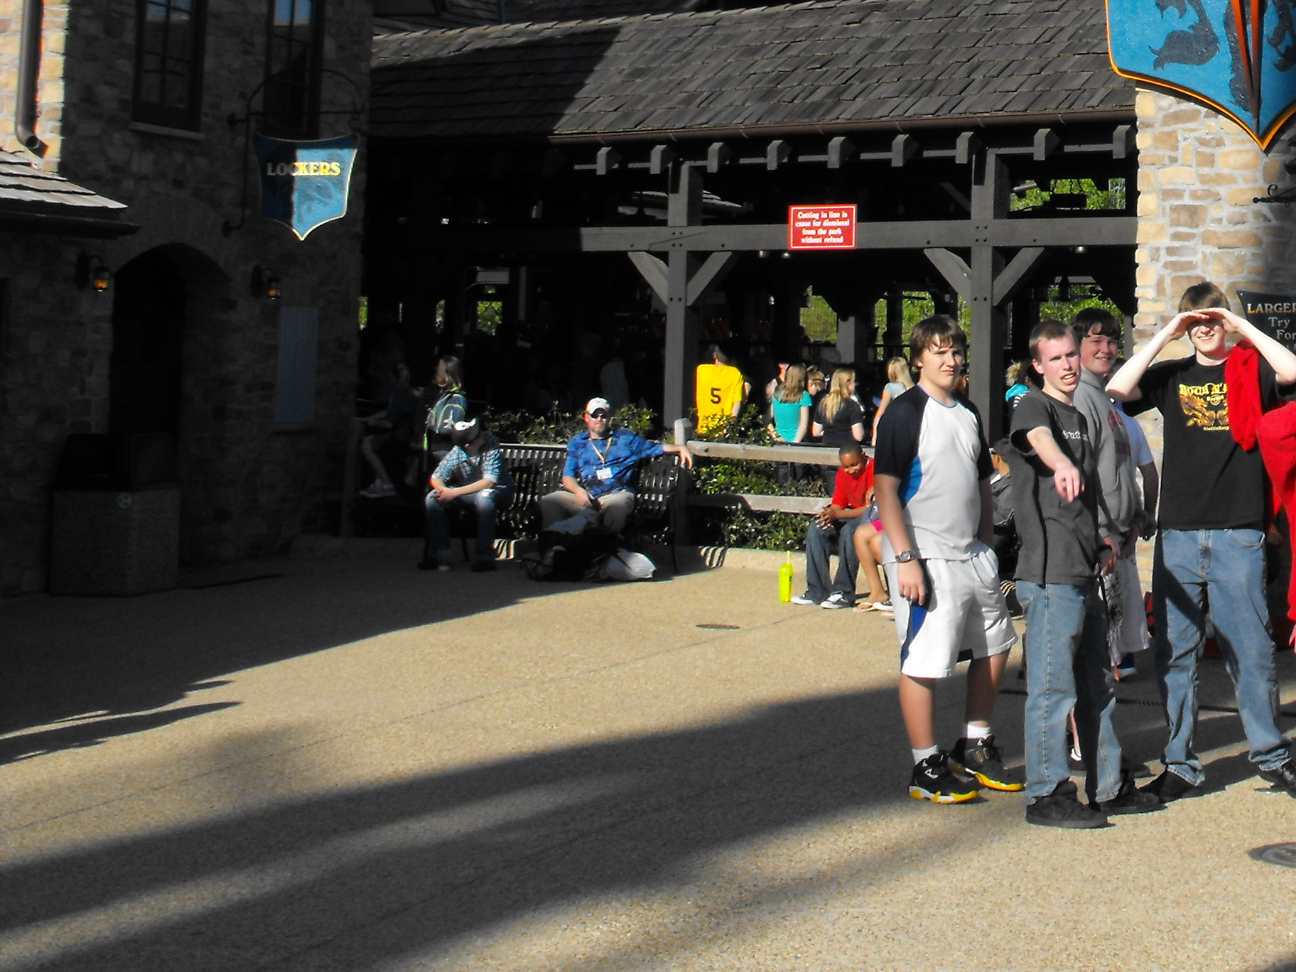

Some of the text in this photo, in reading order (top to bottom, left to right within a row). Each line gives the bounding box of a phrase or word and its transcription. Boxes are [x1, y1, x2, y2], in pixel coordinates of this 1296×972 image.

[266, 161, 341, 176] LOCKERS
[1268, 316, 1291, 329] Try
[710, 387, 722, 405] 5
